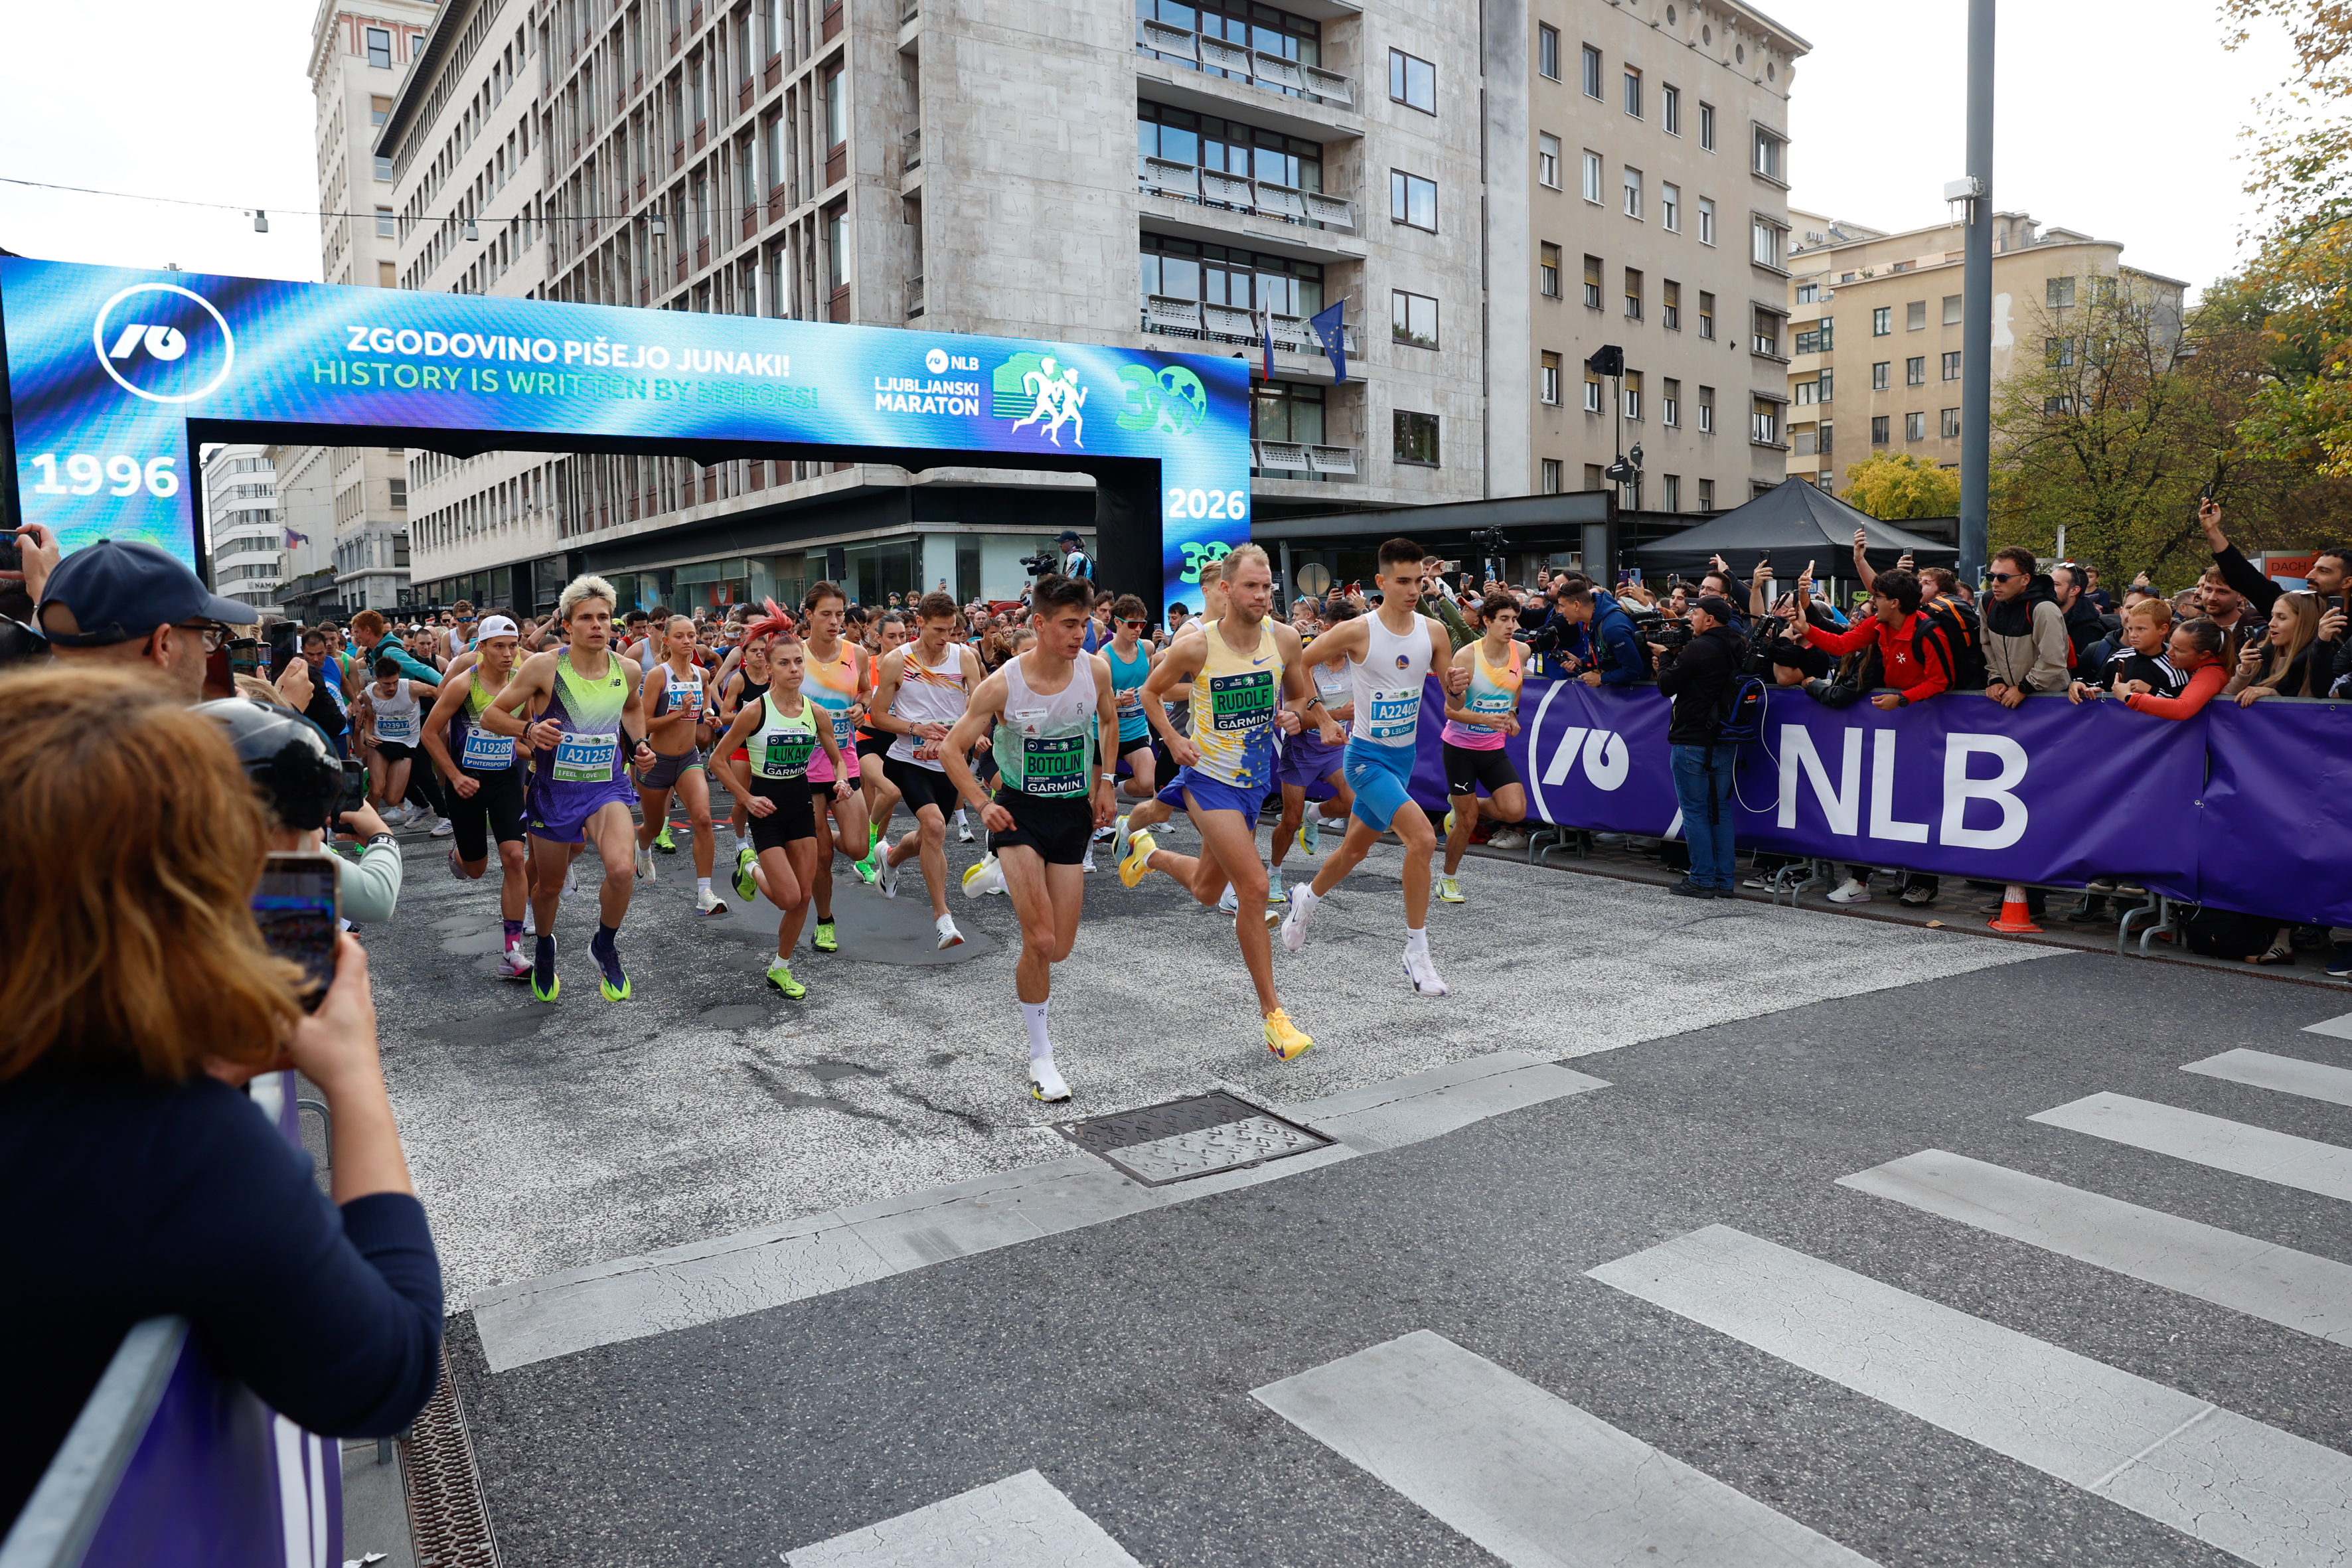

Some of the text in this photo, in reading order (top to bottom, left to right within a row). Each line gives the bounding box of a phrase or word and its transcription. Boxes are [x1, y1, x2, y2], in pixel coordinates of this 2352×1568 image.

[347, 326, 790, 377] ZGODOVINO PIŠEJO JUNAKI!
[951, 356, 979, 370] NLB
[313, 360, 462, 390] HISTORY
[472, 368, 499, 392] IS
[507, 370, 647, 400] WRITTEN
[655, 378, 690, 401] BY
[875, 376, 979, 396] LJUBLJANSKI
[875, 393, 979, 416] MARATON
[32, 453, 179, 498] 1996
[1168, 488, 1245, 520] 2026
[2271, 562, 2307, 572] DACH
[1217, 688, 1269, 711] RUDOLF
[1379, 700, 1418, 719] A22402
[833, 721, 849, 732] 633
[1218, 714, 1269, 729] GARMIN
[1391, 725, 1411, 735] LELOSI
[473, 741, 511, 753] A19289
[565, 748, 613, 762] A21253
[767, 765, 806, 776] GARMIN
[1028, 753, 1081, 773] BOTOLIN
[1028, 779, 1080, 792] GARMIN
[1777, 724, 2029, 850] NLB
